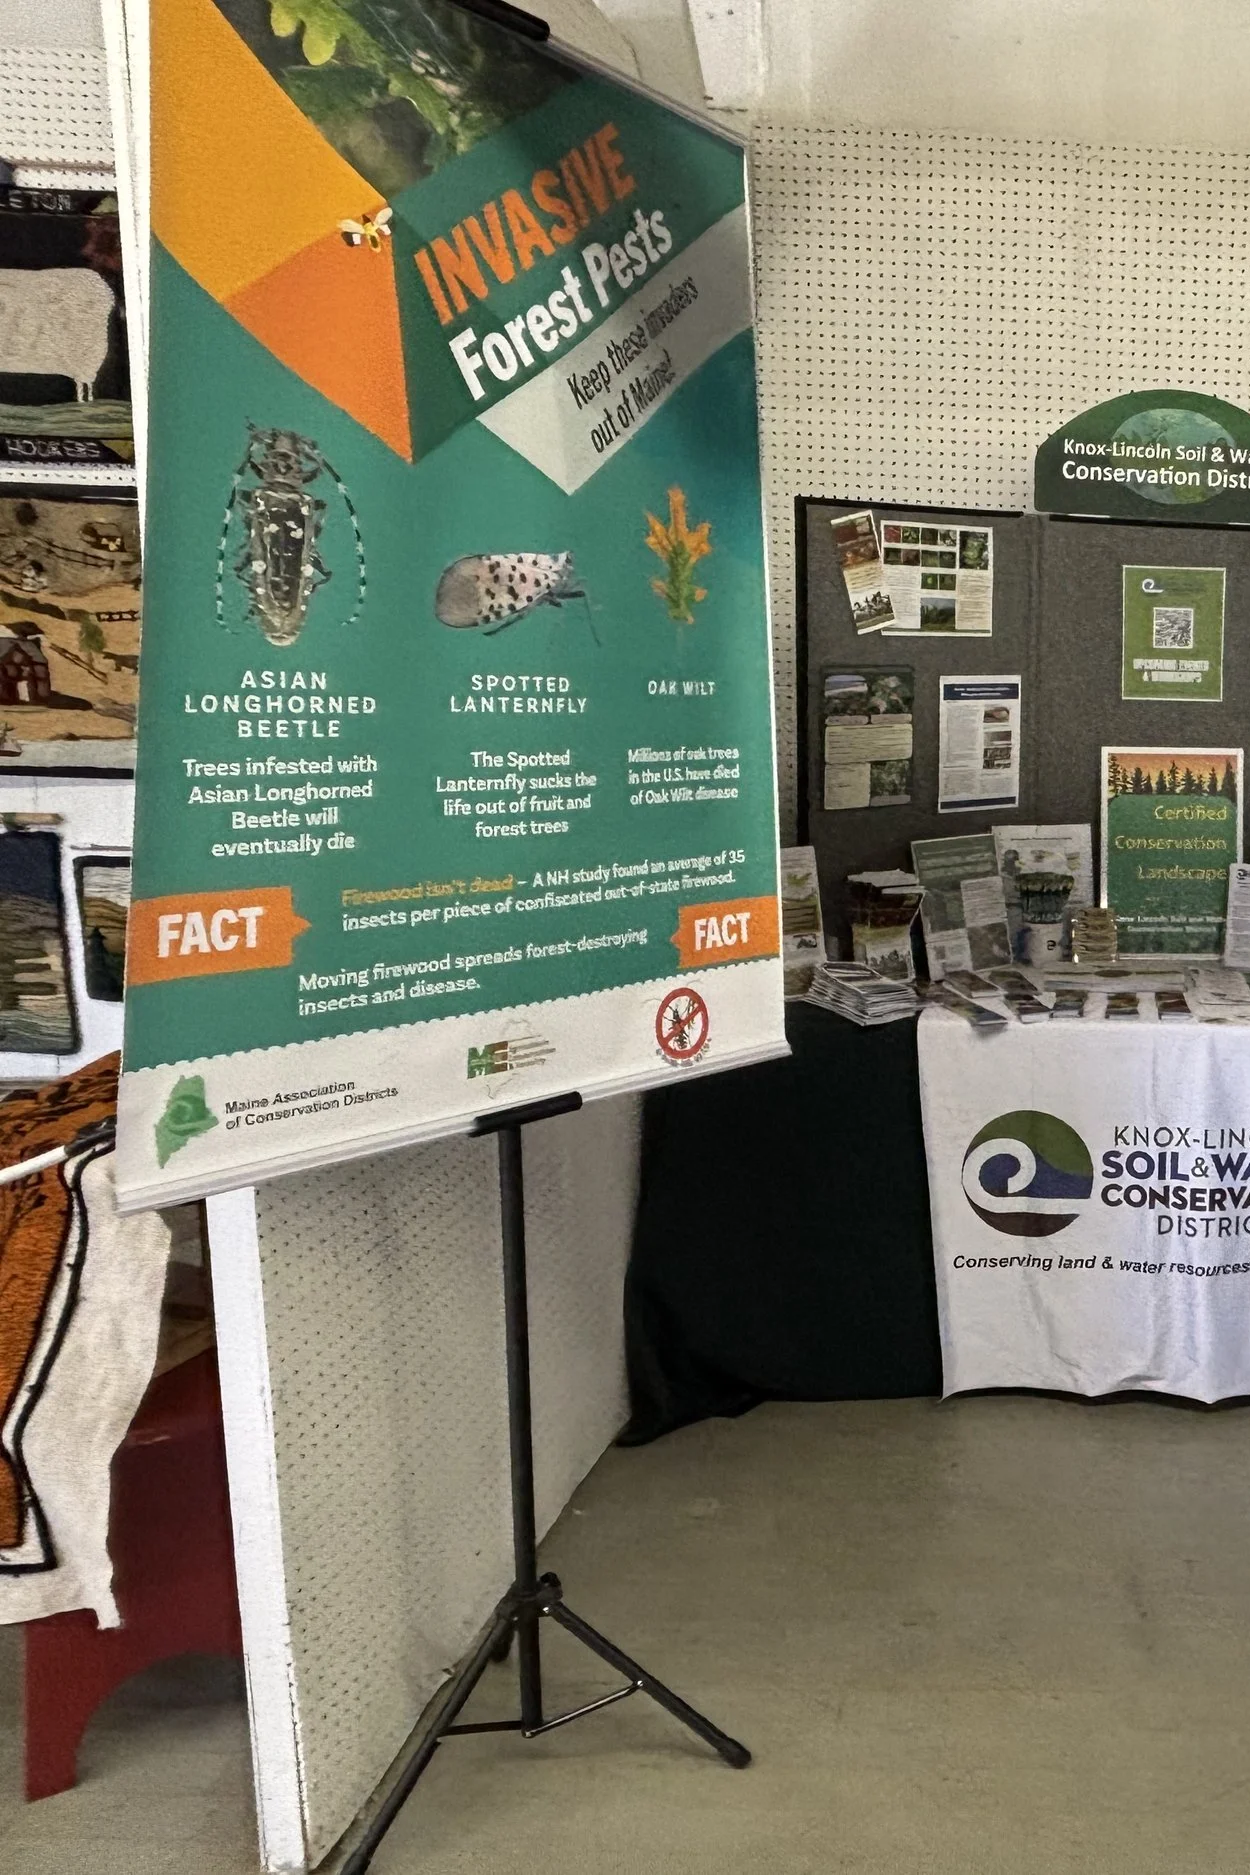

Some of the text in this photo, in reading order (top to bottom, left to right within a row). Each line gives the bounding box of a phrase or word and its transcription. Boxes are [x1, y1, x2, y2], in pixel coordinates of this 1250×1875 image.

[413, 121, 636, 325] INVASIVE
[449, 208, 673, 400] Forest Pests
[566, 360, 611, 409] Keep
[590, 407, 620, 453] out
[617, 386, 635, 428] of
[1064, 439, 1171, 460] Knox-Lincoln
[1175, 446, 1206, 462] Soil
[1211, 446, 1225, 463] &
[1062, 460, 1200, 486] Conservation
[240, 670, 327, 689] ASIAN
[471, 674, 570, 692] SPOTTED
[648, 680, 715, 696] OAK WILT
[184, 694, 376, 714] LONGHORNED
[450, 695, 587, 714] LANTERNFLY
[237, 719, 341, 738] BEETLE
[470, 749, 571, 771] The Spotted
[673, 746, 686, 761] of
[708, 747, 739, 760] trees
[182, 754, 378, 777] Trees infested with
[628, 769, 640, 785] in
[642, 768, 660, 784] the
[713, 763, 740, 780] died
[188, 779, 373, 805] Asian Longhorned
[436, 771, 597, 794] Lanternfly sucks the
[443, 794, 591, 816] life out of fruit and
[630, 789, 644, 805] of
[645, 788, 669, 804] Oak
[231, 806, 339, 829] Beetle will
[1154, 804, 1227, 821] Certified
[475, 820, 569, 838] forest trees
[211, 831, 355, 857] eventually die
[1115, 834, 1227, 850] Conservation
[532, 872, 544, 888] A
[546, 869, 569, 886] NH
[572, 864, 610, 884] study
[612, 859, 648, 877] found
[650, 861, 665, 874] an
[713, 850, 726, 866] of
[728, 849, 745, 864] 35
[1138, 864, 1227, 883] Landscape
[343, 909, 407, 931] insects
[411, 908, 440, 926] per
[444, 901, 491, 923] piece
[494, 896, 513, 913] of
[515, 886, 602, 911] confiscated
[157, 905, 264, 958] FACT
[694, 912, 751, 951] FACT
[299, 928, 648, 992] Moving firewood spreads forest-destroying
[299, 977, 481, 1016] insects and disease.
[225, 1081, 356, 1114] Maine Association
[225, 1087, 399, 1130] of Conservation Districts
[953, 1254, 1053, 1271] Conserving
[1058, 1255, 1097, 1269] land
[1101, 1256, 1114, 1269] &
[1119, 1259, 1166, 1274] water
[1169, 1260, 1250, 1277] resources
